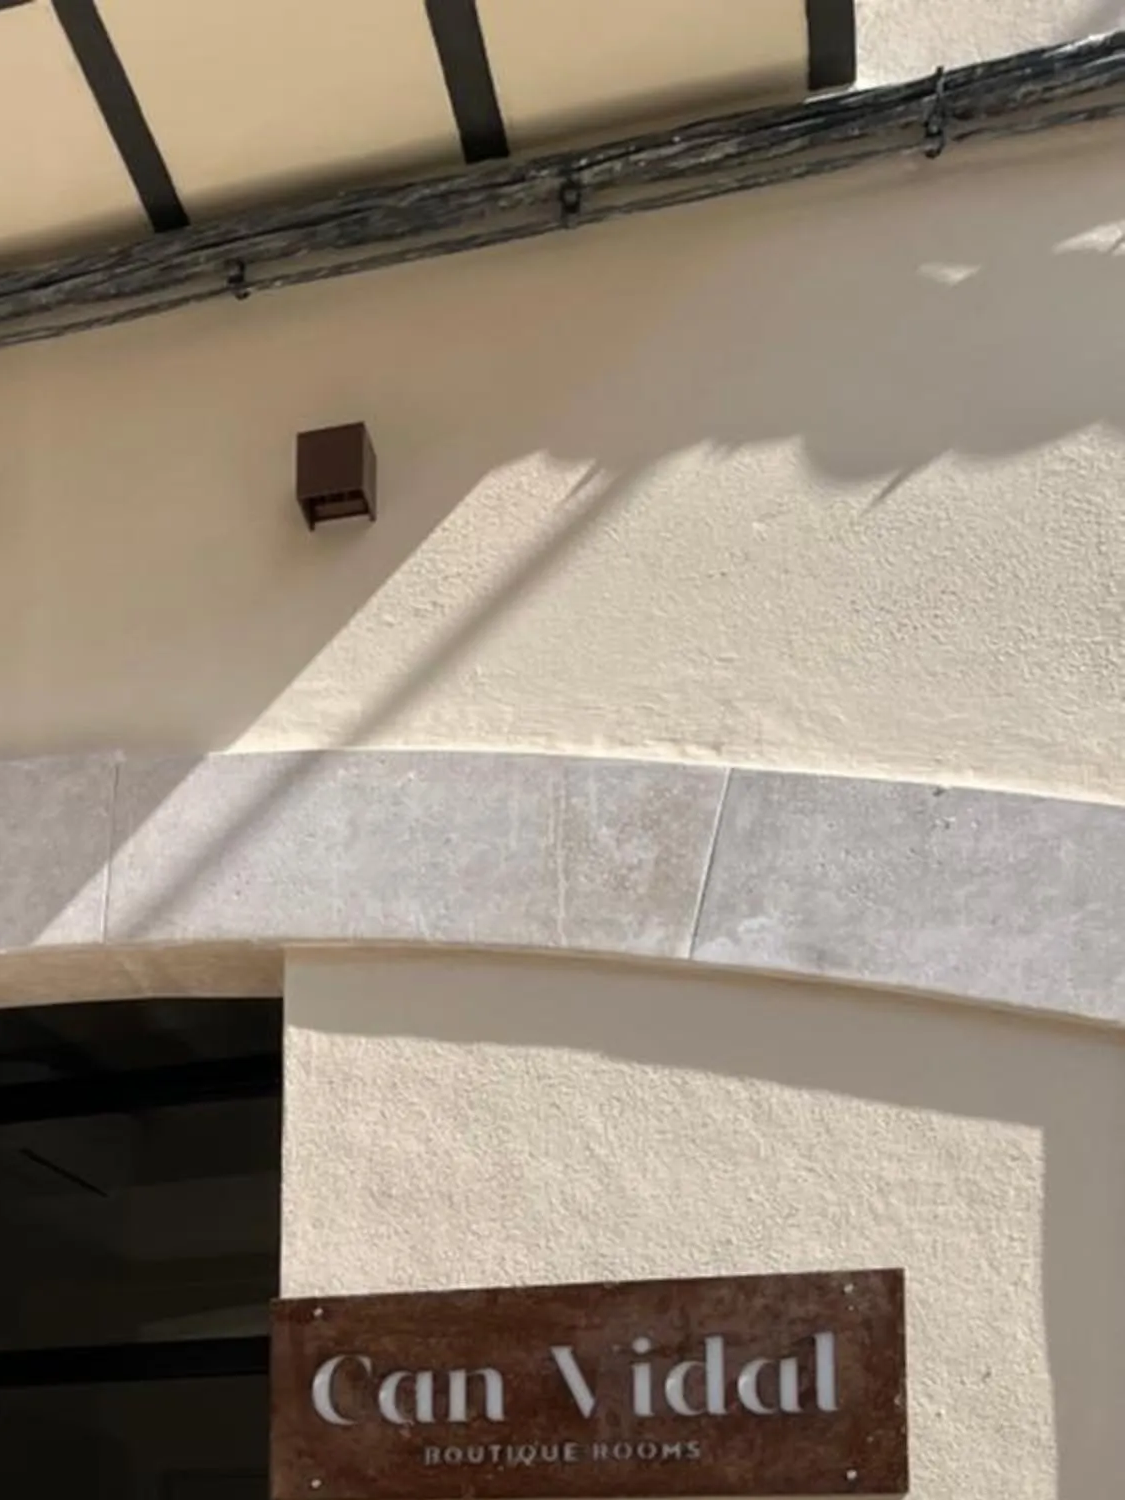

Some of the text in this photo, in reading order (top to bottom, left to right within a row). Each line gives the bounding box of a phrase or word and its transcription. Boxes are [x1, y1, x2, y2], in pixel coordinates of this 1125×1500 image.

[312, 1332, 839, 1425] Can Vidal
[424, 1441, 702, 1465] BOUTIQUE ROOMS
